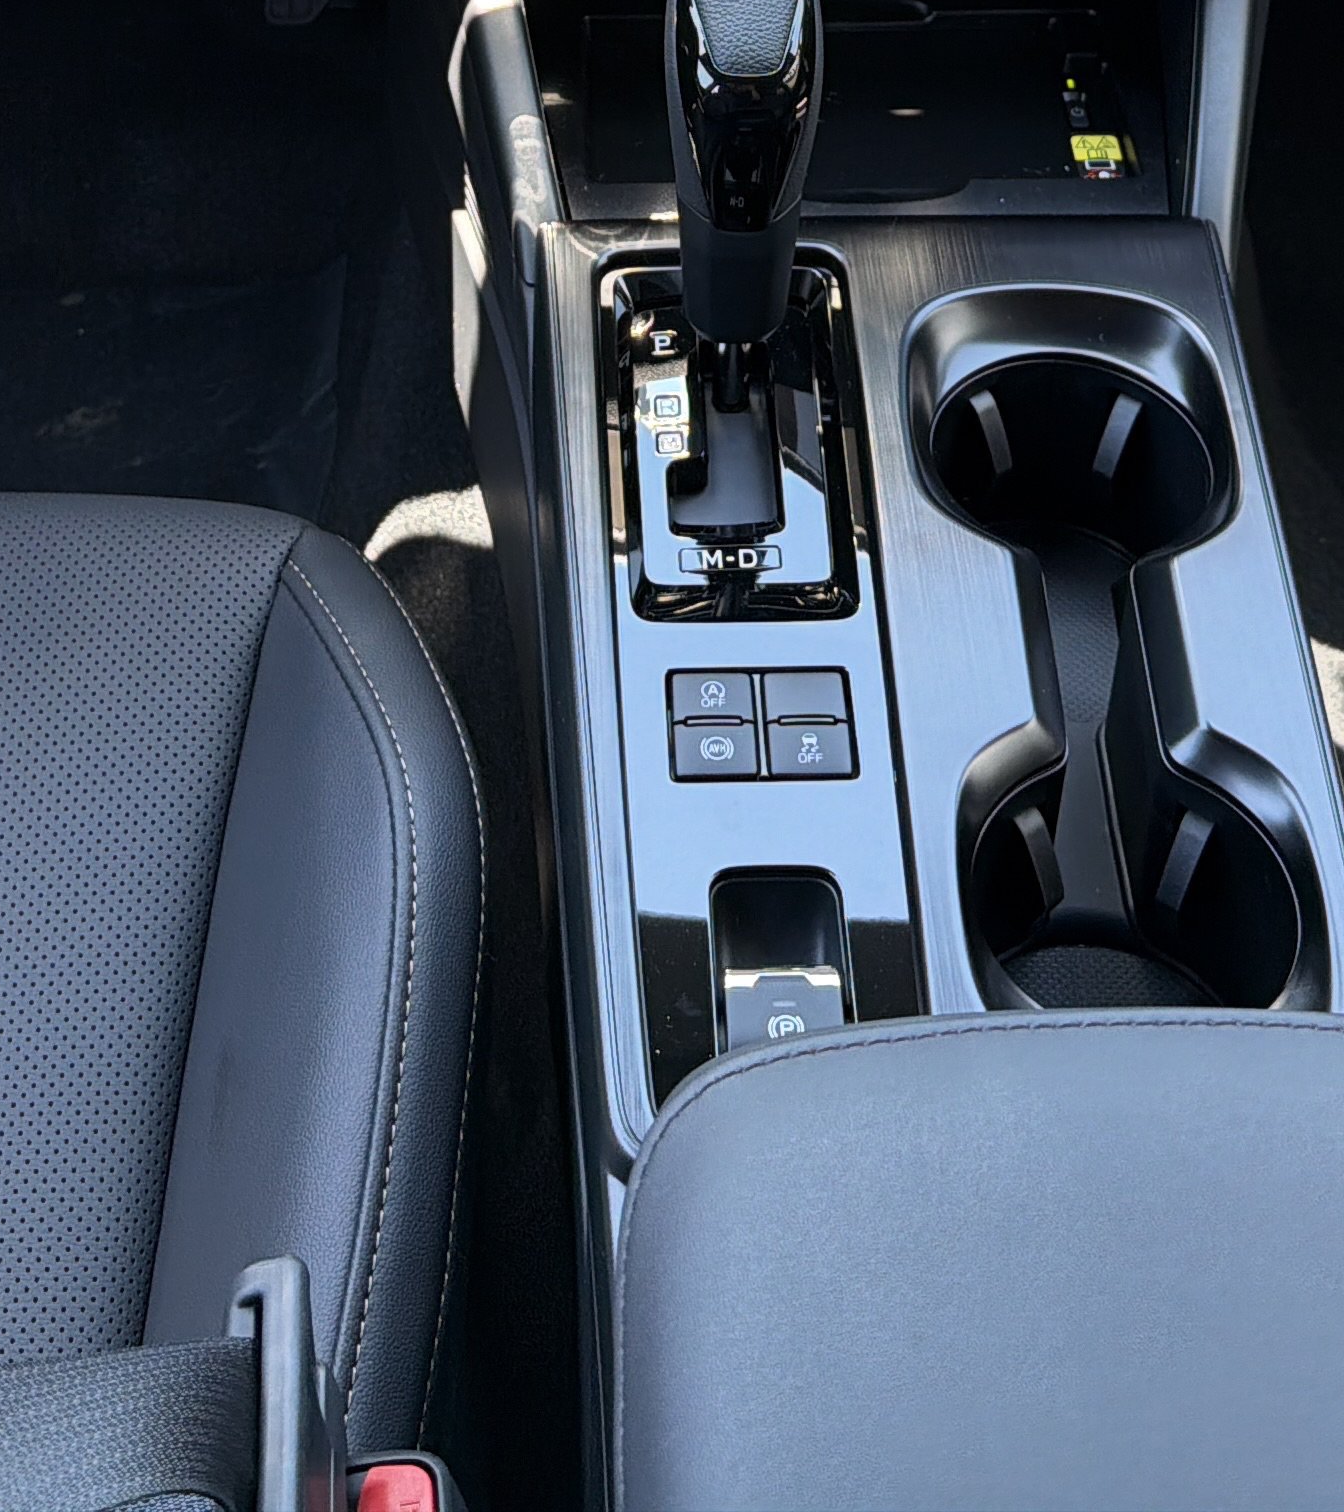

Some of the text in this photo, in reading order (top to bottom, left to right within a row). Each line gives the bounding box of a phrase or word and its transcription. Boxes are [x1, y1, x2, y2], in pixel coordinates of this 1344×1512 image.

[655, 335, 671, 352] P
[660, 399, 676, 415] R
[701, 548, 758, 569] M-D
[700, 696, 726, 708] OFF
[708, 742, 728, 754] AVH
[797, 751, 824, 764] OFF
